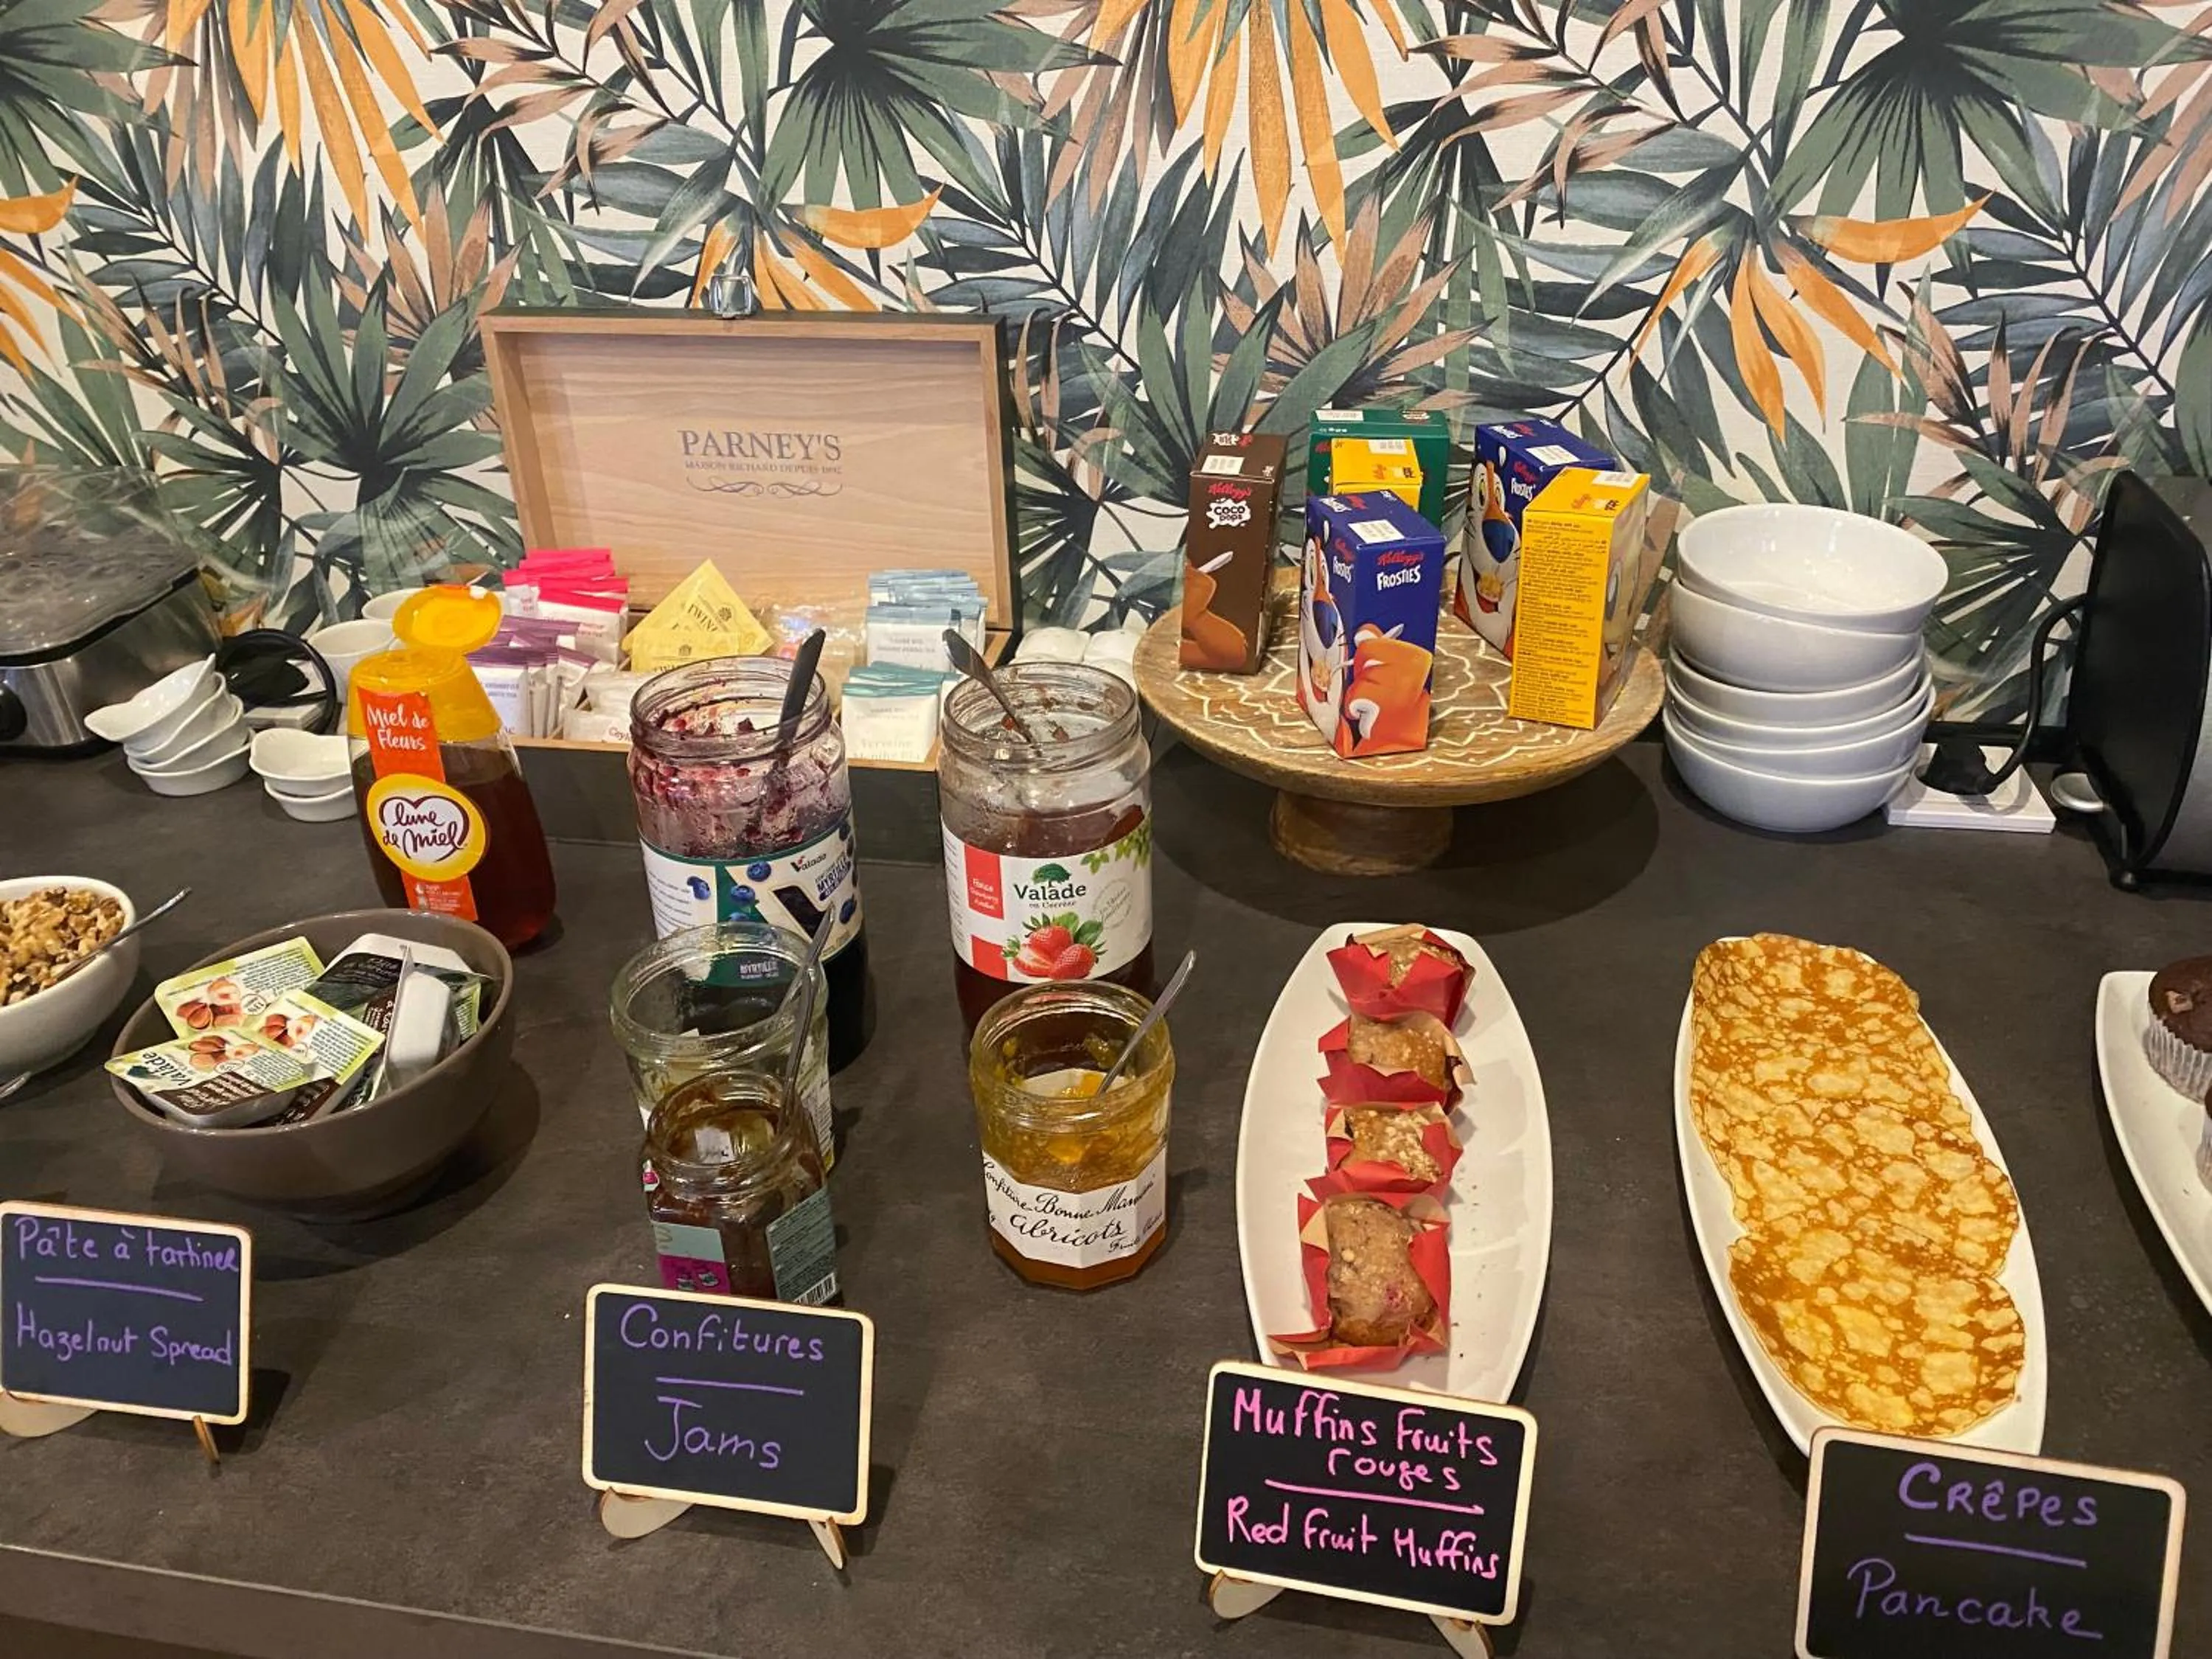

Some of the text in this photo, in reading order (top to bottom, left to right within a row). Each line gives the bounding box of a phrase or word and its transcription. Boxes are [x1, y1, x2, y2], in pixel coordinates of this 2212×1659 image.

[677, 430, 841, 461] PARNEY'S
[1377, 564, 1422, 591] FROSTIES
[366, 703, 431, 729] Miel de
[377, 728, 426, 751] Fleurs
[393, 802, 445, 827] lune
[383, 830, 400, 849] de
[1013, 883, 1086, 900] Valade
[1034, 1192, 1094, 1219] Bonne
[15, 1217, 98, 1260] Pâte
[114, 1228, 136, 1259] à
[16, 1301, 232, 1366] Hazelnut Spread
[620, 1303, 824, 1362] Confitures
[644, 1396, 782, 1469] Jams
[1233, 1388, 1377, 1446] Muffins
[1328, 1447, 1462, 1492] rouges
[1227, 1495, 1290, 1545] Red
[1394, 1527, 1500, 1580] Muffins
[1847, 1557, 2104, 1641] Pancake
